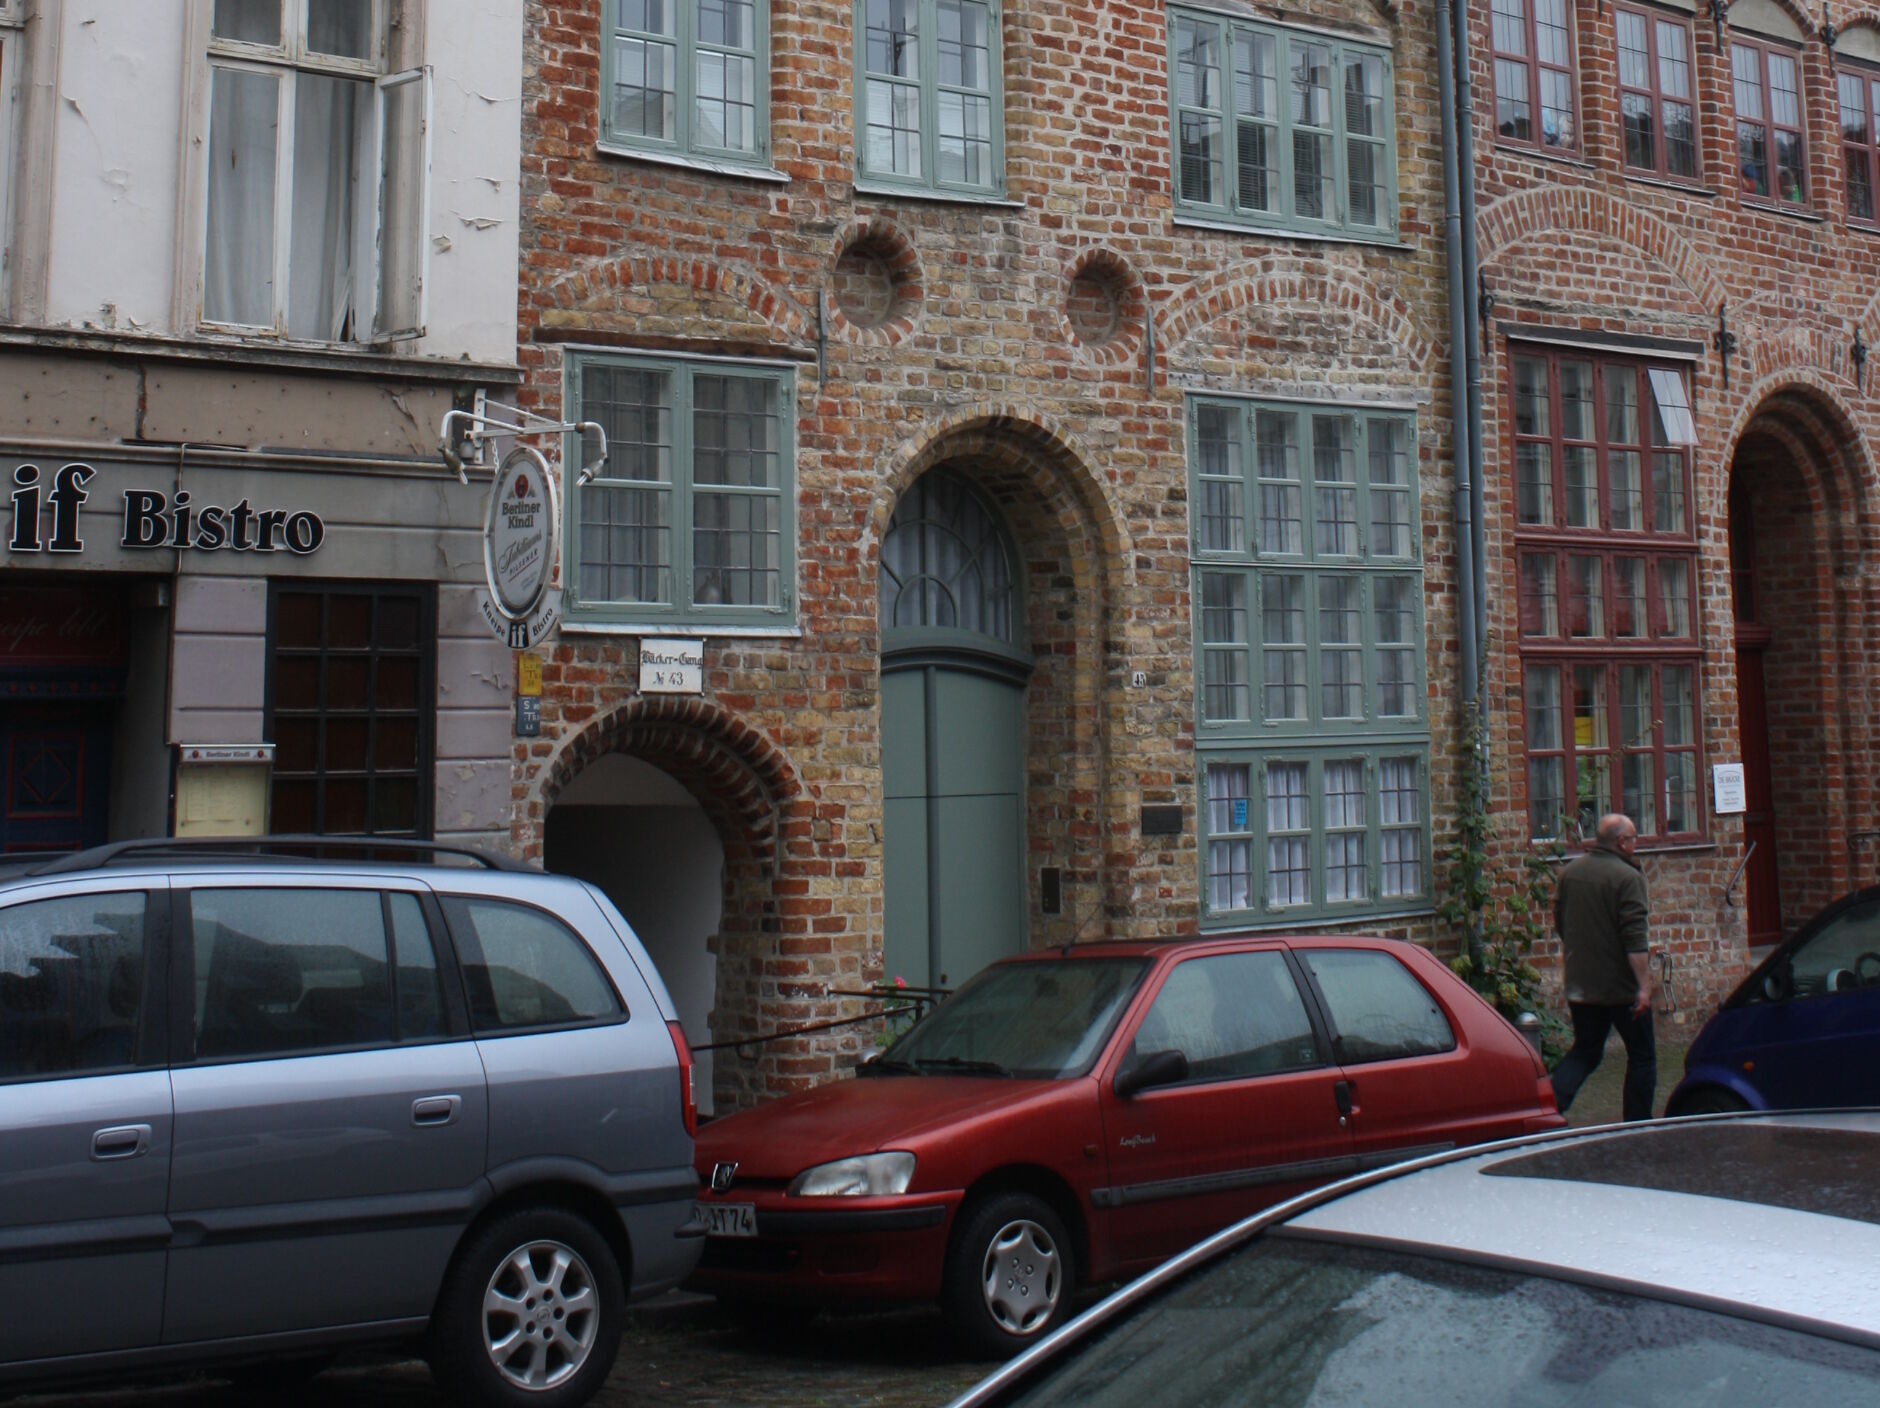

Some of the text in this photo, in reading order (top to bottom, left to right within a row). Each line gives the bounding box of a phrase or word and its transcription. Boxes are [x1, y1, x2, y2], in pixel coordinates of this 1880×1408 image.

[9, 462, 325, 554] if Bistro
[502, 501, 541, 516] Berliner
[507, 515, 534, 529] Kindl
[532, 607, 553, 637] Bistro
[669, 671, 684, 686] 43
